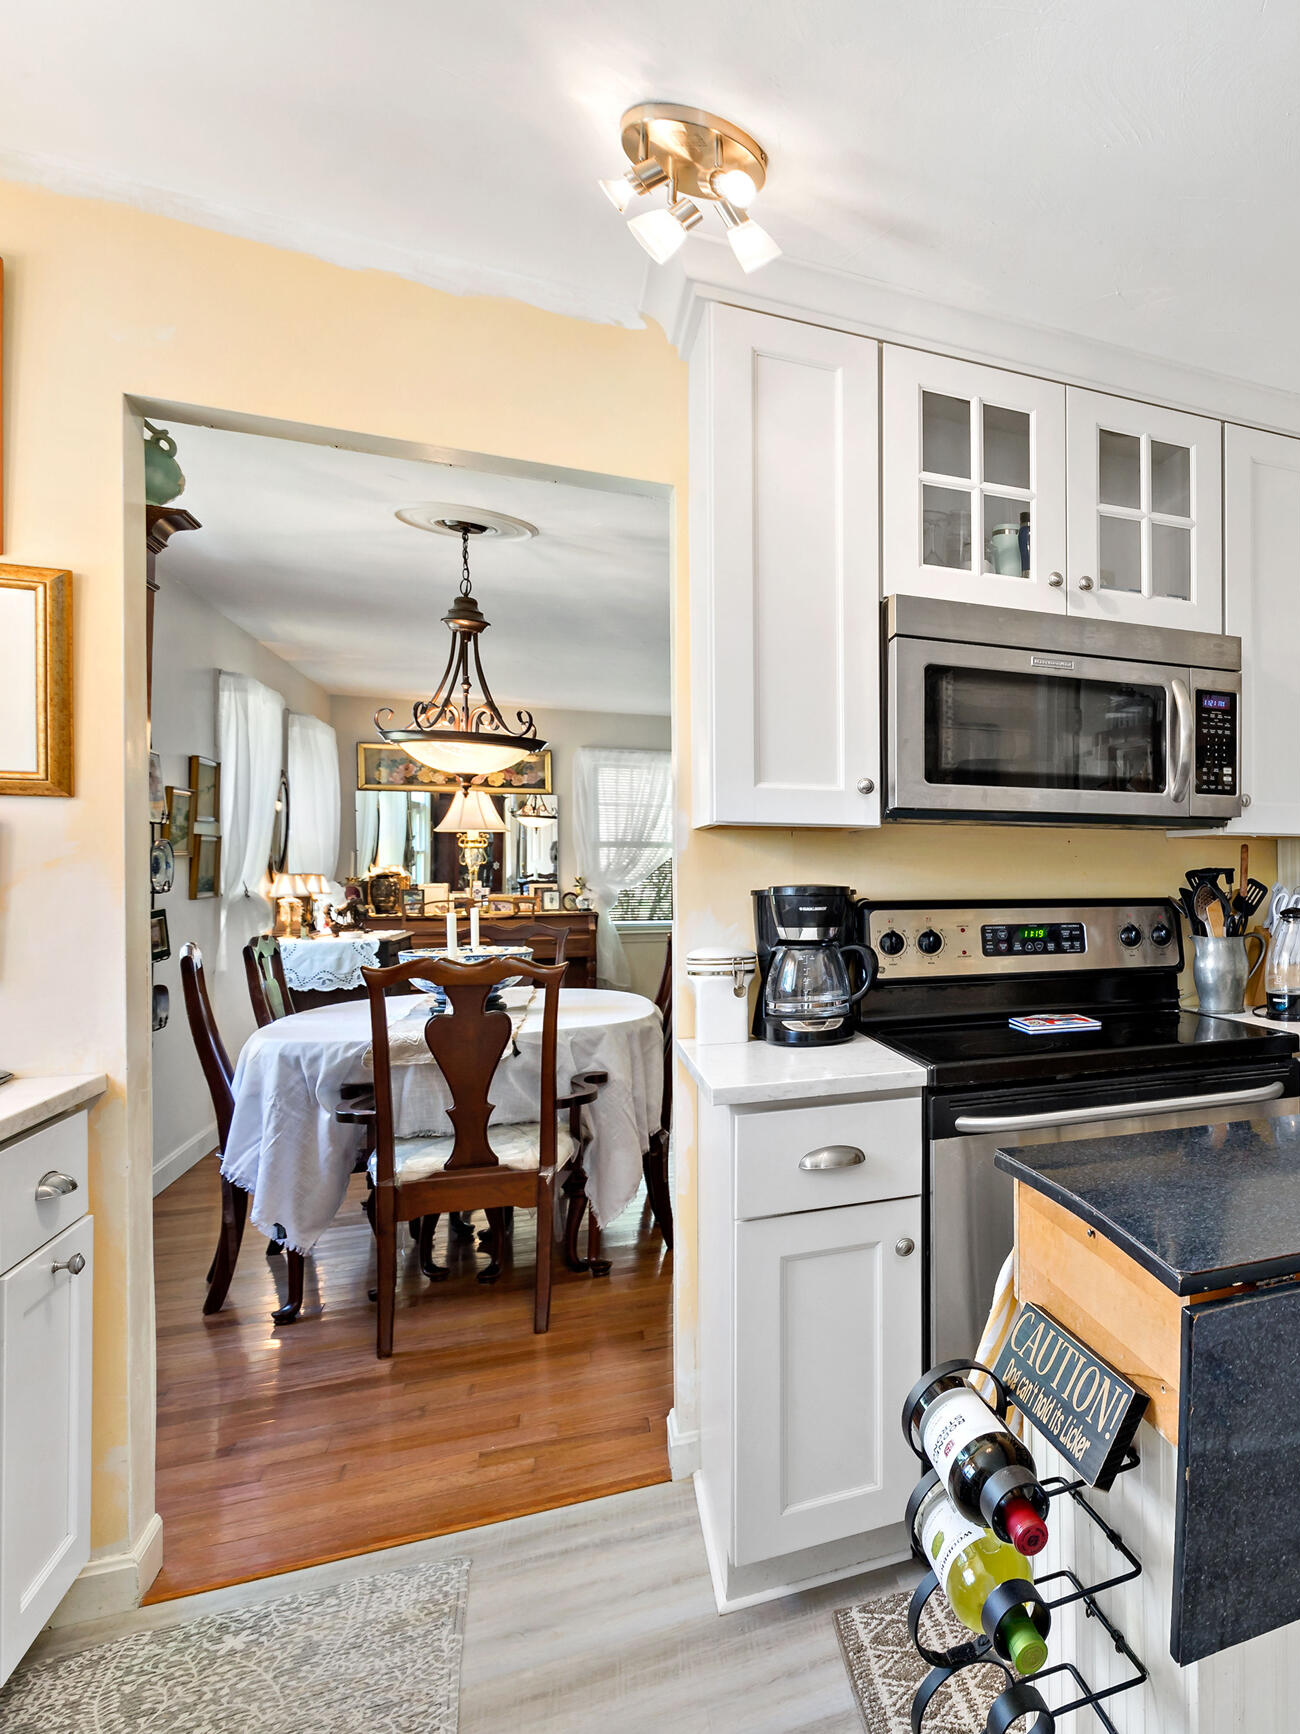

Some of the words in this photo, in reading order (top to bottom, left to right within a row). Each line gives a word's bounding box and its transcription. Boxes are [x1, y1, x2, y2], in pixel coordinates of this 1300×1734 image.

[1024, 929, 1044, 938] 11:19
[1002, 1357, 1023, 1391] Dog
[1016, 1376, 1040, 1408] can't
[1031, 1387, 1057, 1425] hold
[1047, 1403, 1065, 1436] its
[1059, 1415, 1092, 1462] Licker
[1010, 1311, 1129, 1440] CAUTION!
